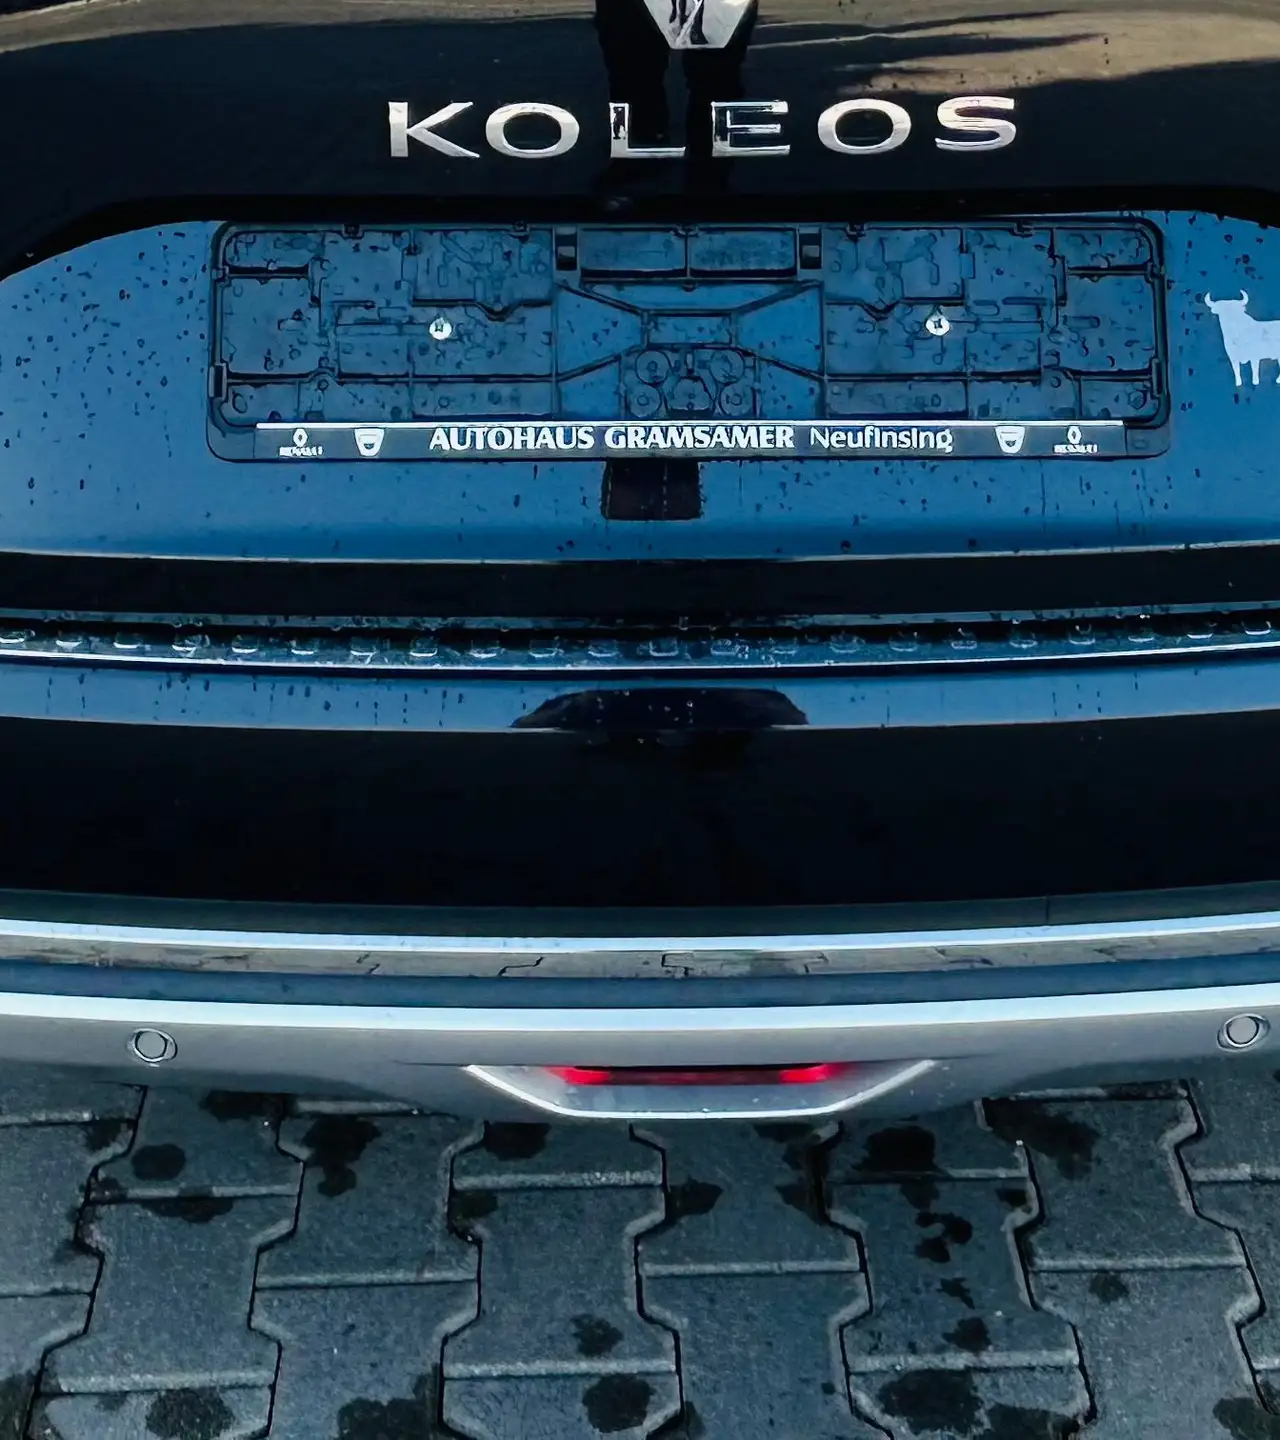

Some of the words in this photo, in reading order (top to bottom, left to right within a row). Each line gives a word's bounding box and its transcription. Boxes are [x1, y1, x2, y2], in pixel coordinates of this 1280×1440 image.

[387, 95, 1017, 158] KOLEOS
[428, 426, 595, 450] AUTOHAUS
[604, 425, 795, 450] GRAMSAMER
[809, 425, 954, 454] Neufinsing
